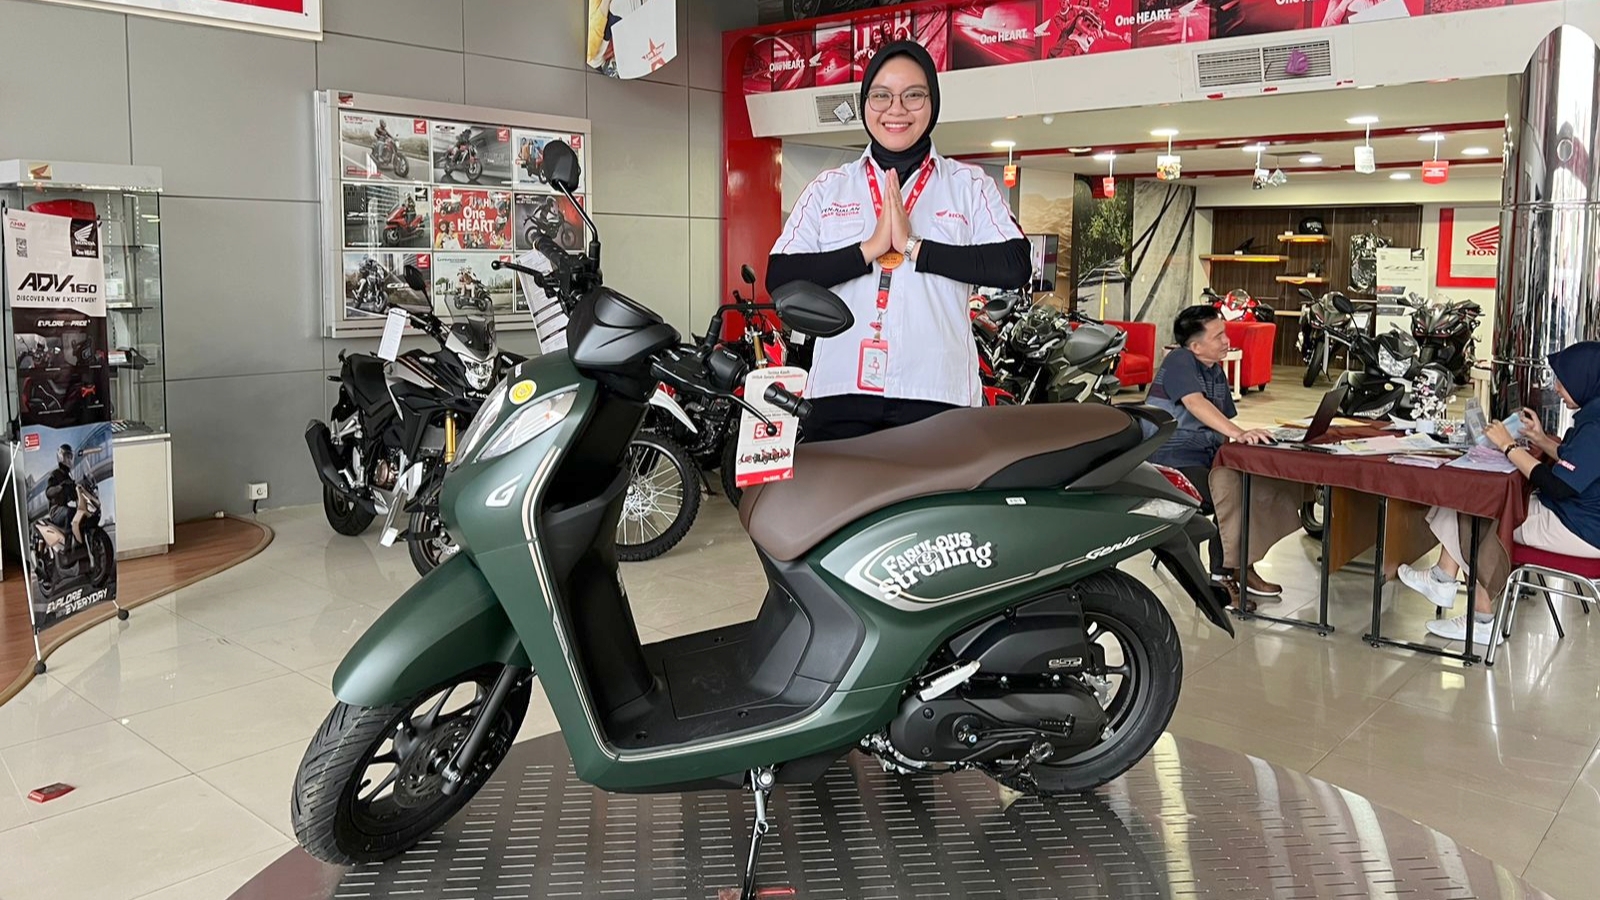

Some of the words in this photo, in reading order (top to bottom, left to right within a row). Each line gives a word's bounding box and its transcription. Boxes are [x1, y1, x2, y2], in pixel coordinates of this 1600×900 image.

[1115, 14, 1135, 27] One
[1136, 8, 1172, 24] HEART.
[979, 33, 997, 45] One
[997, 28, 1028, 42] HEART.
[463, 206, 486, 219] One
[1085, 534, 1140, 560] Genio
[879, 541, 992, 600] Strolling
[46, 588, 82, 614] EXPLORE
[65, 588, 107, 615] EVERYDAY
